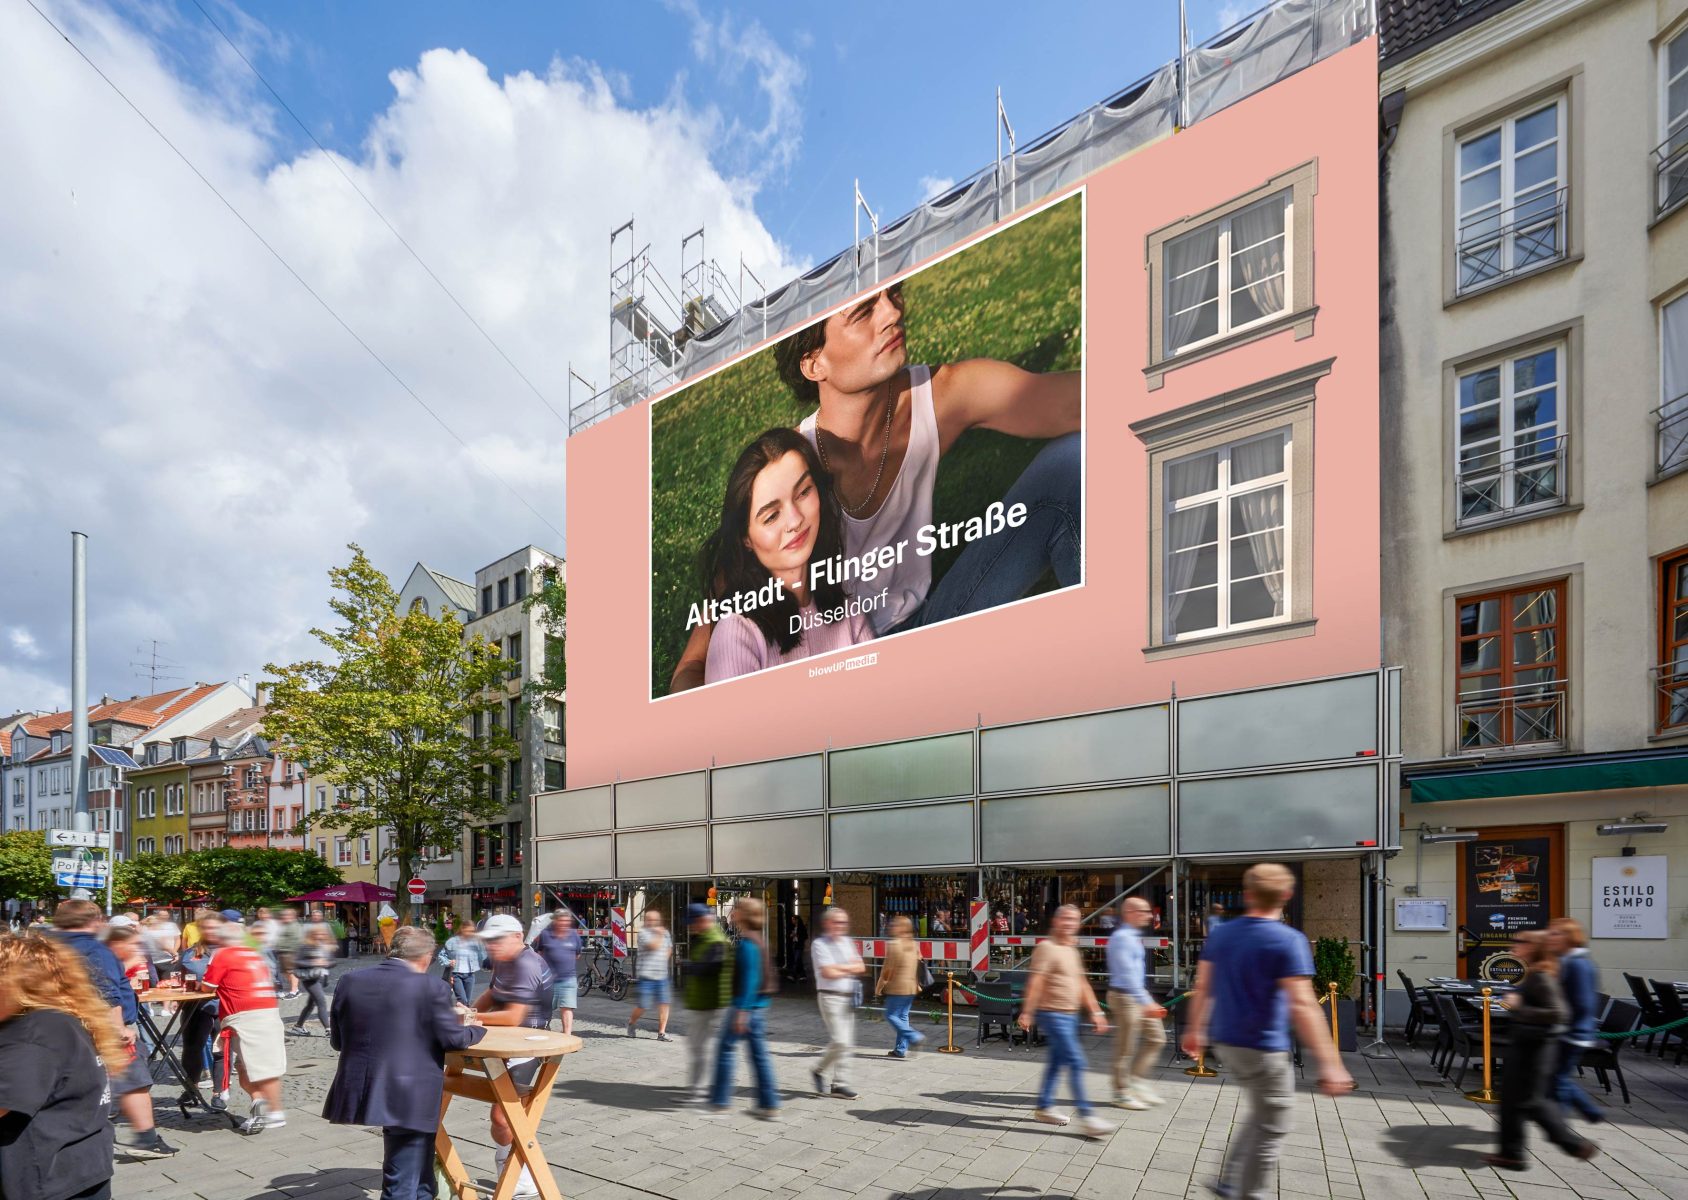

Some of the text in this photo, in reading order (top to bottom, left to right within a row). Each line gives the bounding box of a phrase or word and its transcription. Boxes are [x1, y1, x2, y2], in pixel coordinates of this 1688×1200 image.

[685, 500, 1028, 631] Altstadt - Flinger Straße
[789, 588, 889, 635] Düsseldorf
[1603, 885, 1655, 896] ESTILO
[1603, 897, 1654, 907] CAMPO
